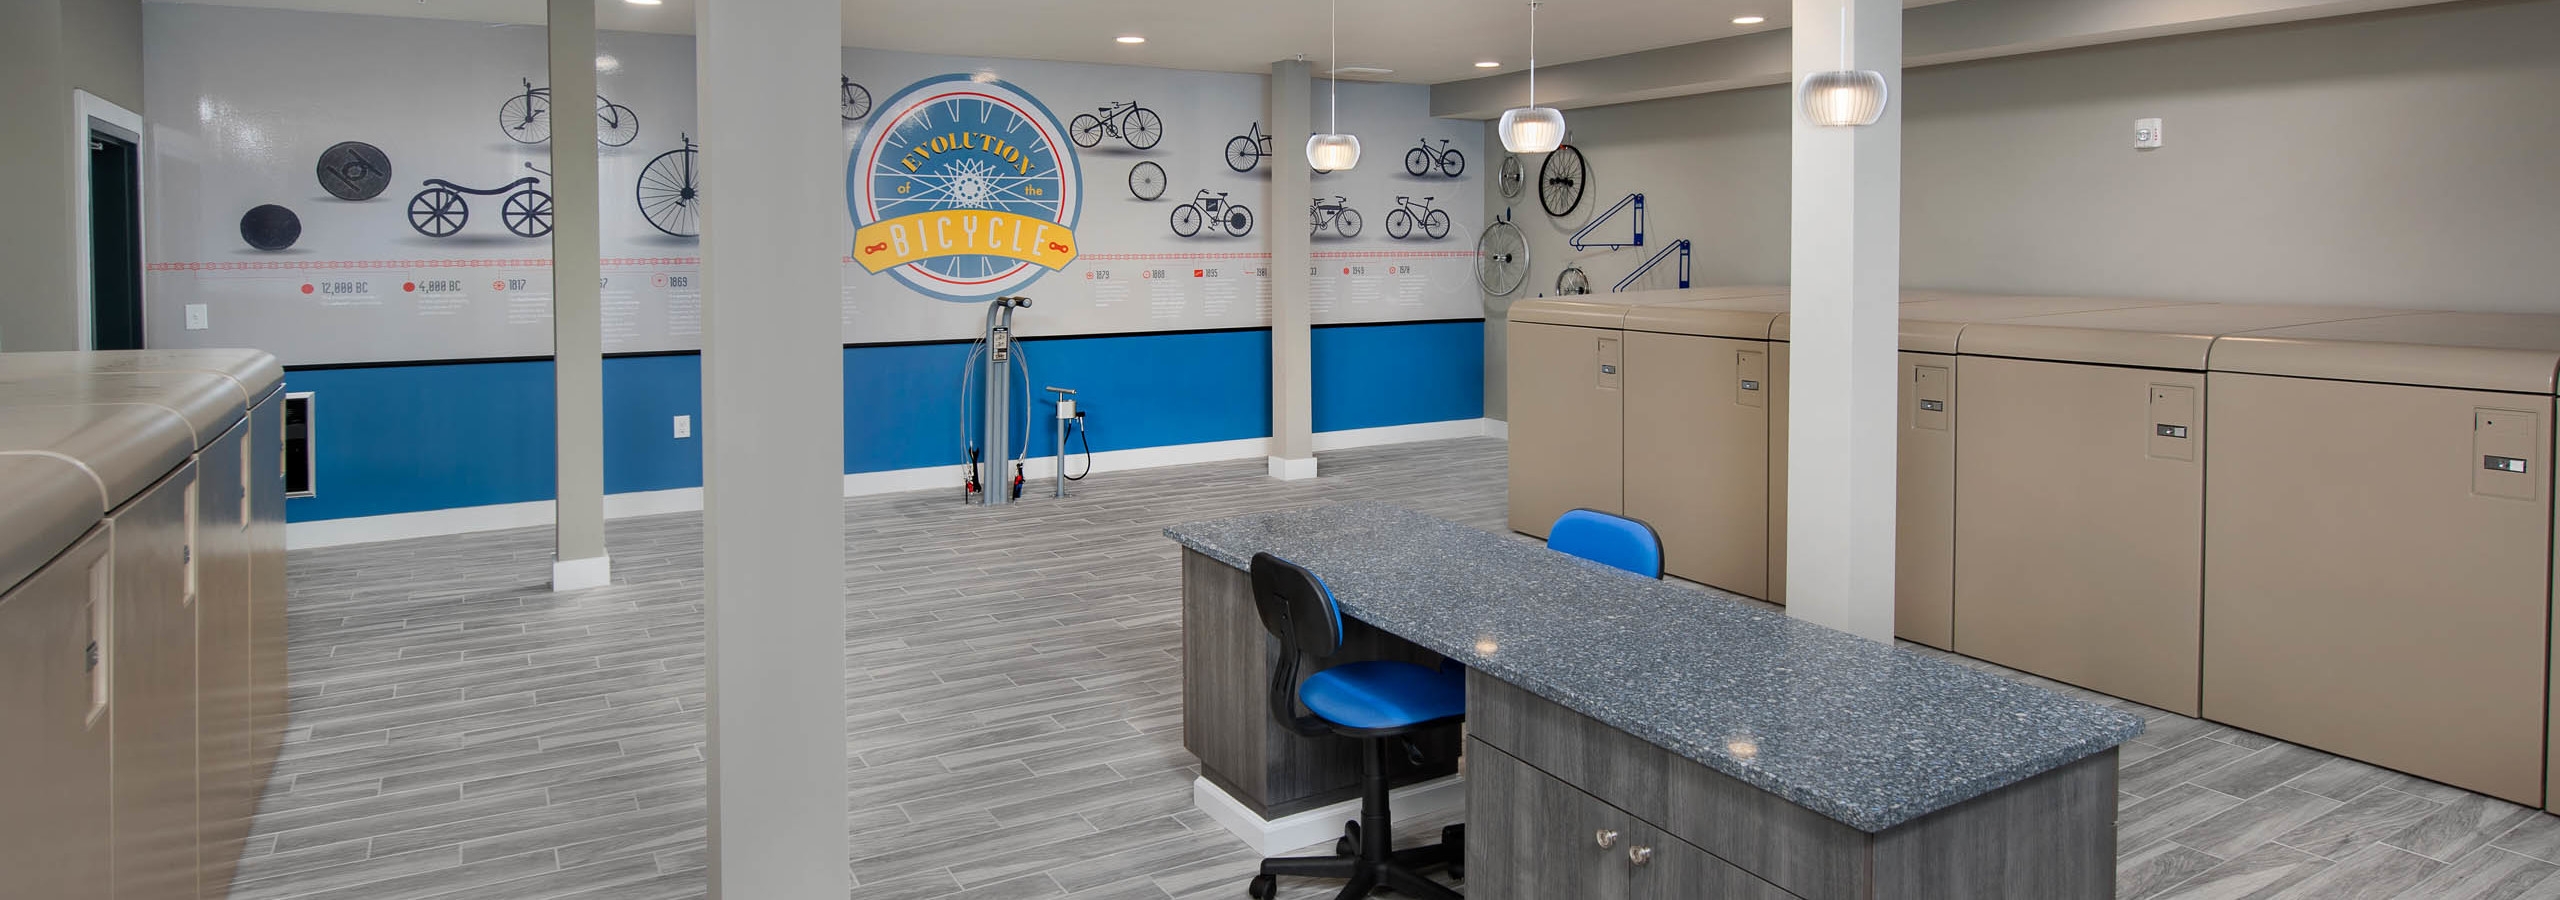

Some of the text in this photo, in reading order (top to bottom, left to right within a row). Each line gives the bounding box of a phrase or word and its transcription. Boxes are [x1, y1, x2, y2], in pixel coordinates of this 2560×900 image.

[901, 132, 1036, 175] EVOLUTION
[897, 182, 1043, 196] of the
[889, 215, 1049, 257] BICYCLE
[356, 281, 368, 293] BC
[449, 280, 461, 292] BC
[508, 279, 527, 291] 1817
[669, 276, 688, 287] 1869
